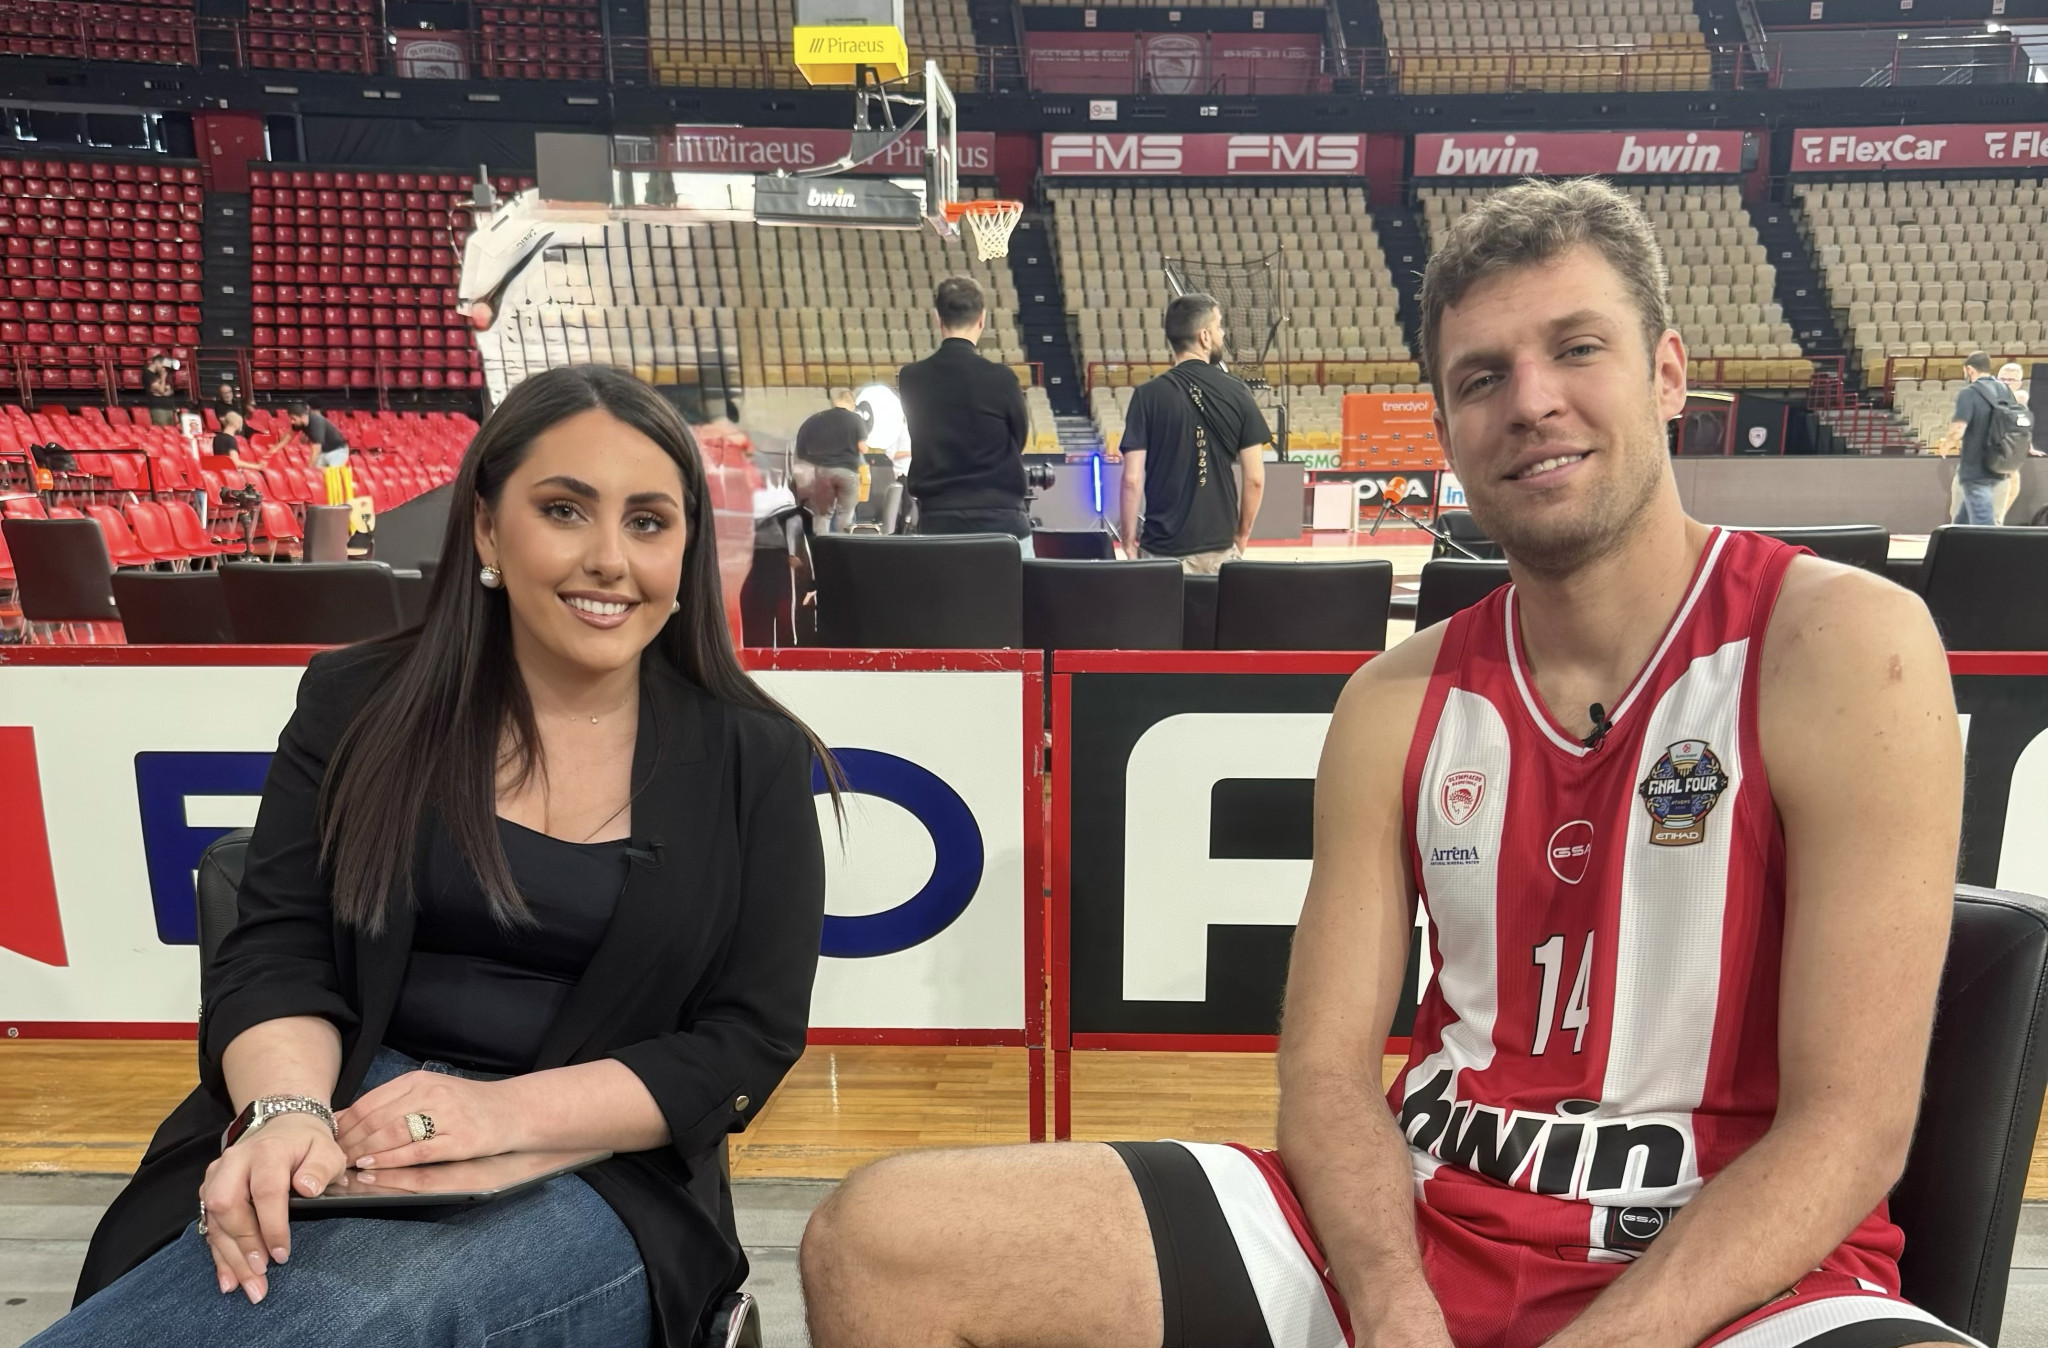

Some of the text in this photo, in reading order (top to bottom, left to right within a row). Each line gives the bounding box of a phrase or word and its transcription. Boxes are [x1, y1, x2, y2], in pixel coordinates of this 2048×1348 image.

[828, 38, 885, 53] Piraeus
[887, 139, 988, 169] Pirus
[1051, 135, 1360, 170] FMS FMS
[1436, 133, 1721, 174] bwin bwin
[1828, 134, 1948, 163] FlexCar
[807, 187, 856, 208] bwin
[1382, 401, 1429, 414] trendyol
[1685, 776, 1718, 793] FOUR
[1655, 832, 1699, 840] ETIHAD
[1531, 929, 1595, 1057] 14
[1399, 1068, 1686, 1196] bwin
[1623, 1214, 1660, 1225] GSA
